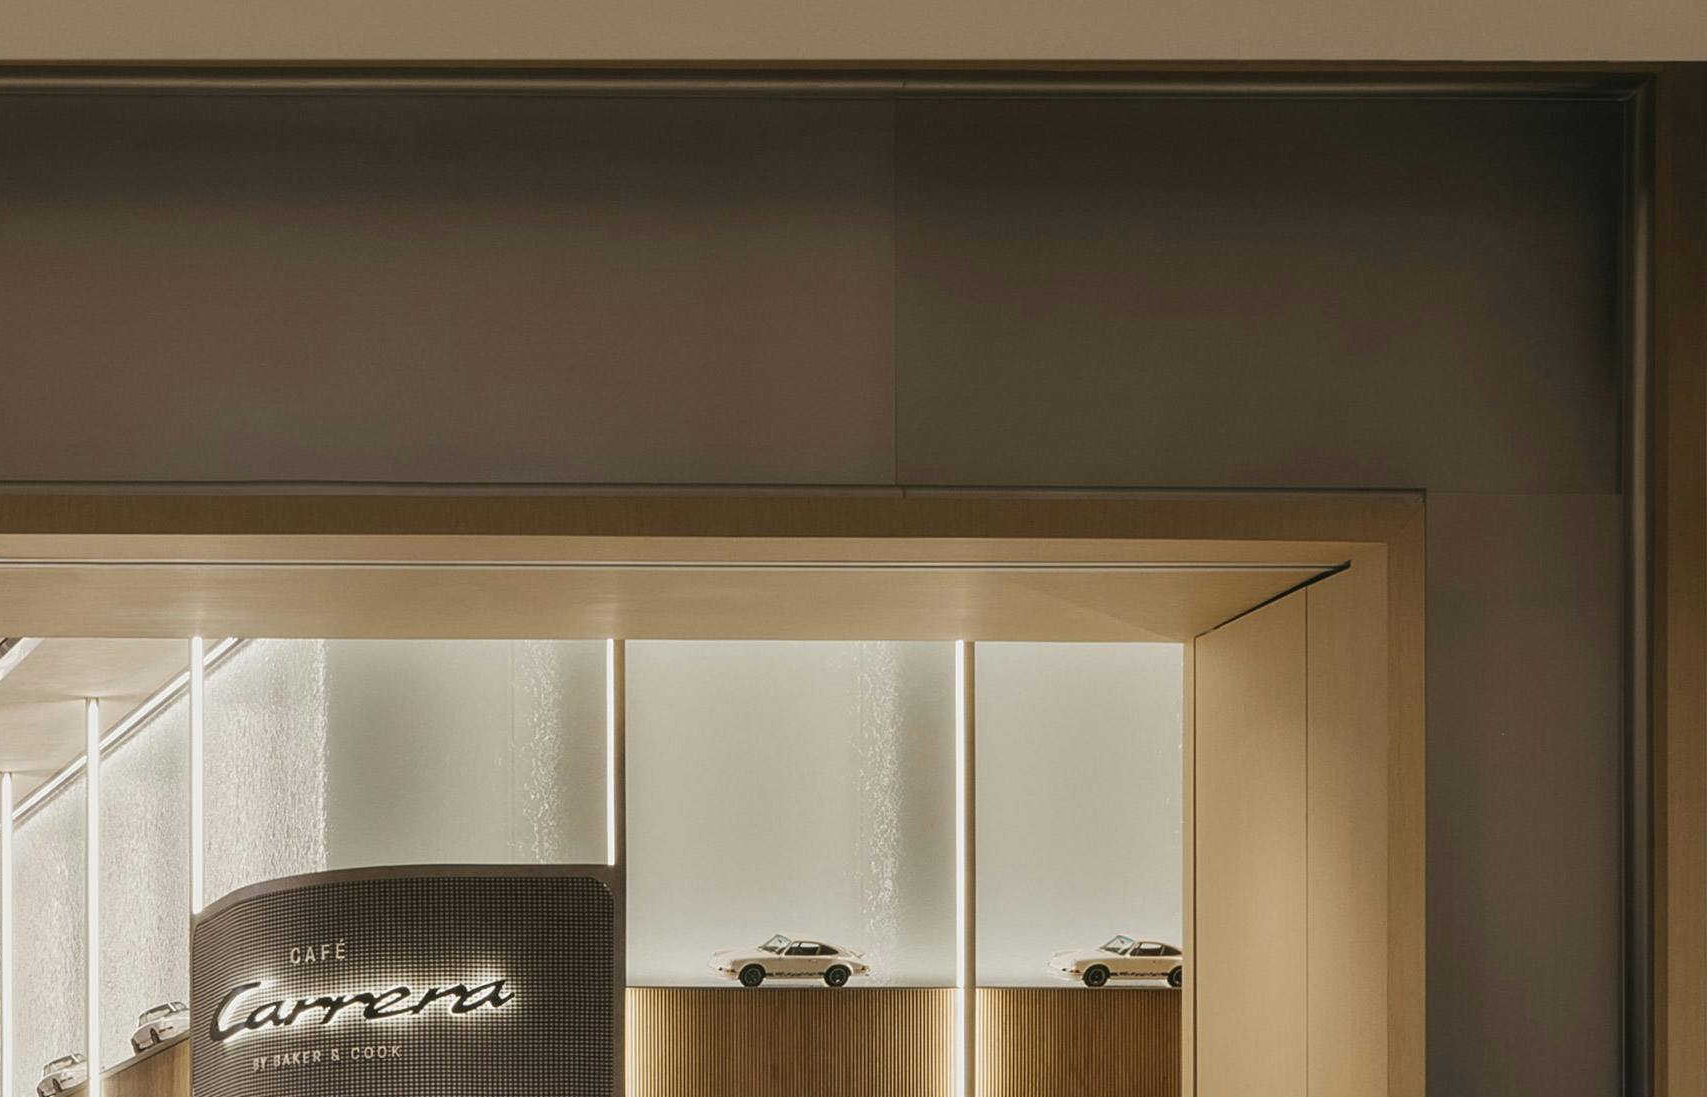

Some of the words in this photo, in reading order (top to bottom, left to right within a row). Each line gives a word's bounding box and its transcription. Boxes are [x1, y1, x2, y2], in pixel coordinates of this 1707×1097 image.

[290, 938, 346, 964] CAFÉ
[210, 979, 515, 1042] Carrera
[252, 1057, 268, 1072] BY
[273, 1049, 322, 1068] BAKER
[330, 1048, 340, 1062] &
[350, 1044, 402, 1060] COOK
